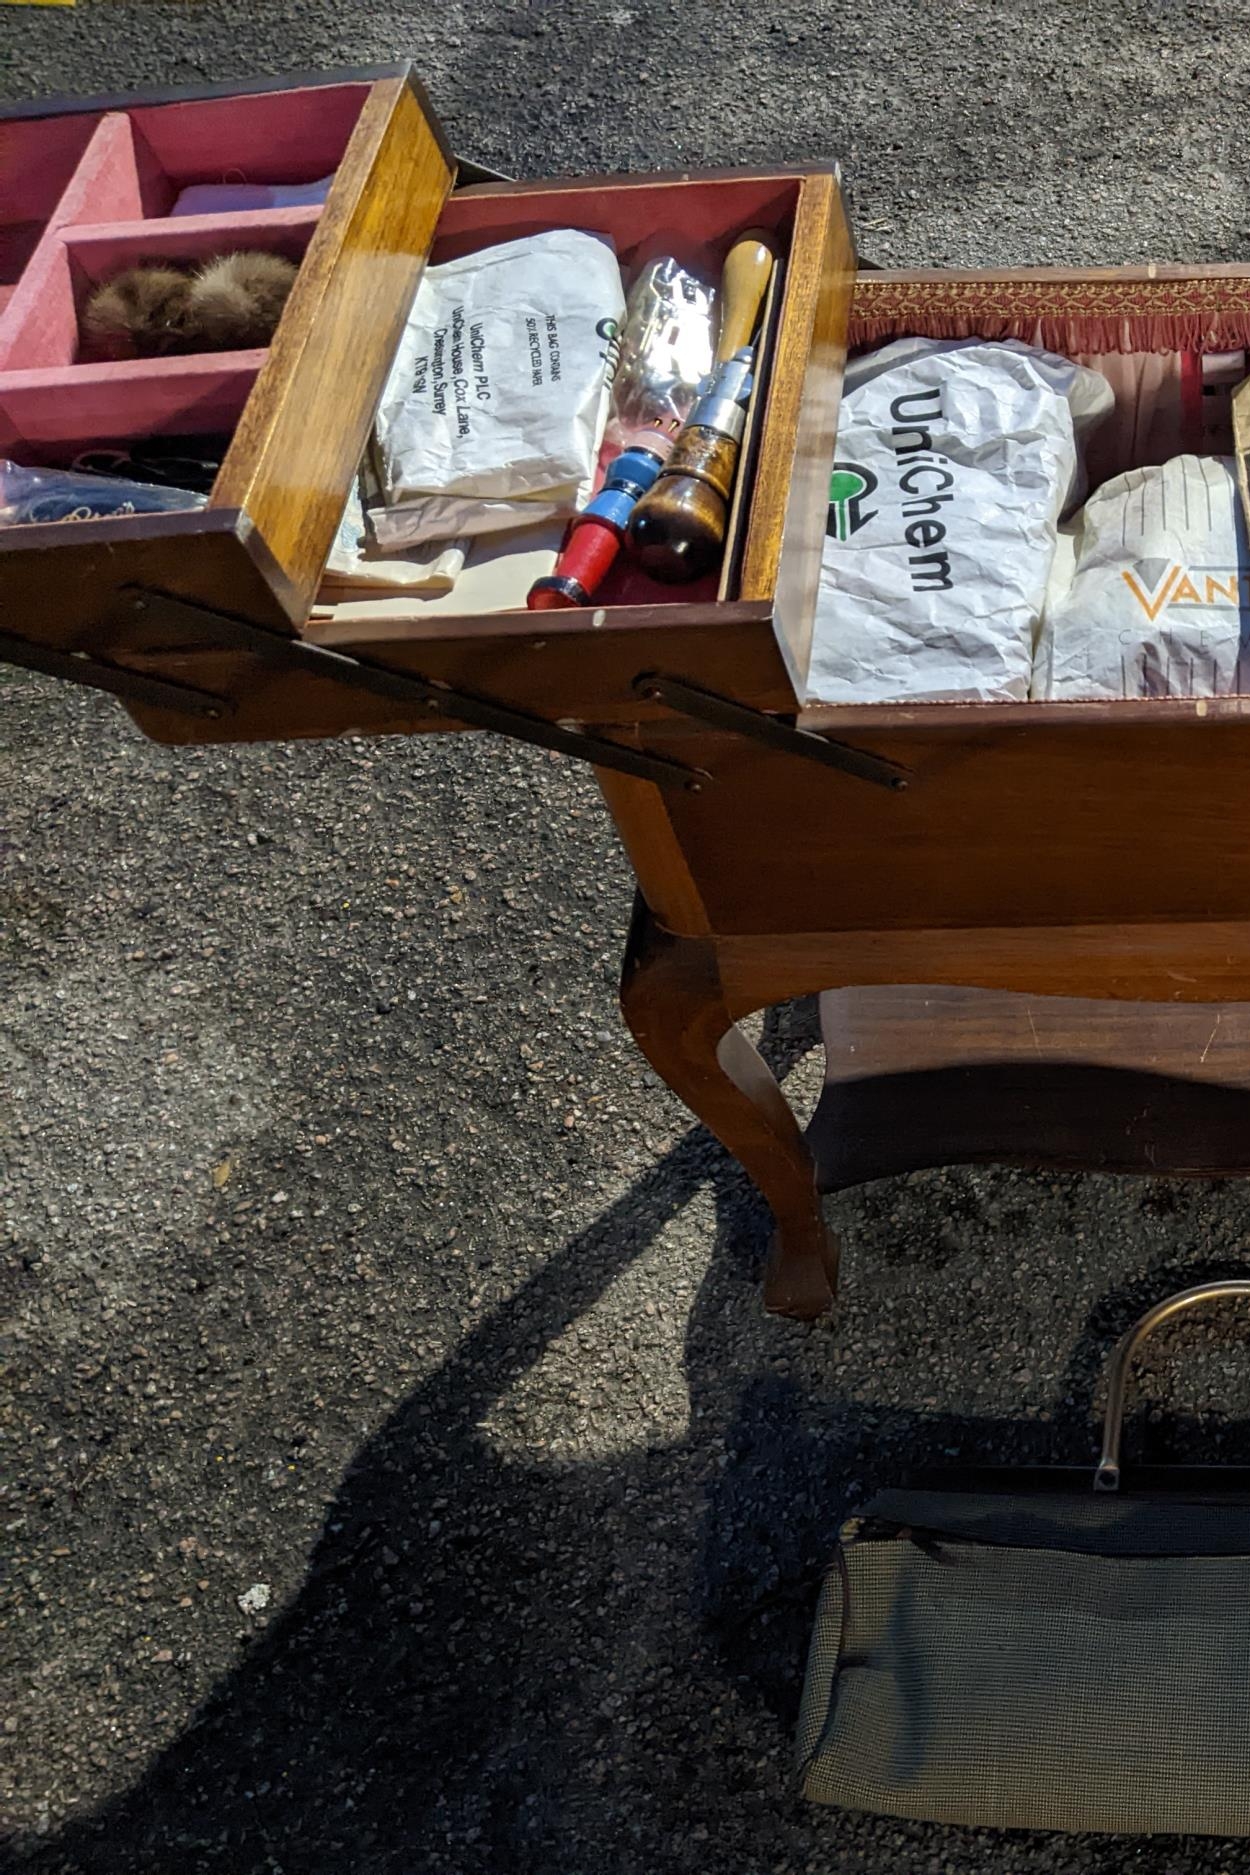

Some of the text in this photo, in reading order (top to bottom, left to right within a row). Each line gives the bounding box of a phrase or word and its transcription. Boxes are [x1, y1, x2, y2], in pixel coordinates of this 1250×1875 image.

[470, 322, 491, 400] UniChem PLC
[525, 317, 543, 387] 50% RECYCLED PAPER
[545, 314, 561, 382] THIS BAG CONTAINS
[454, 378, 469, 402] Cox
[456, 405, 471, 439] Lane,
[889, 388, 955, 592] UniChem
